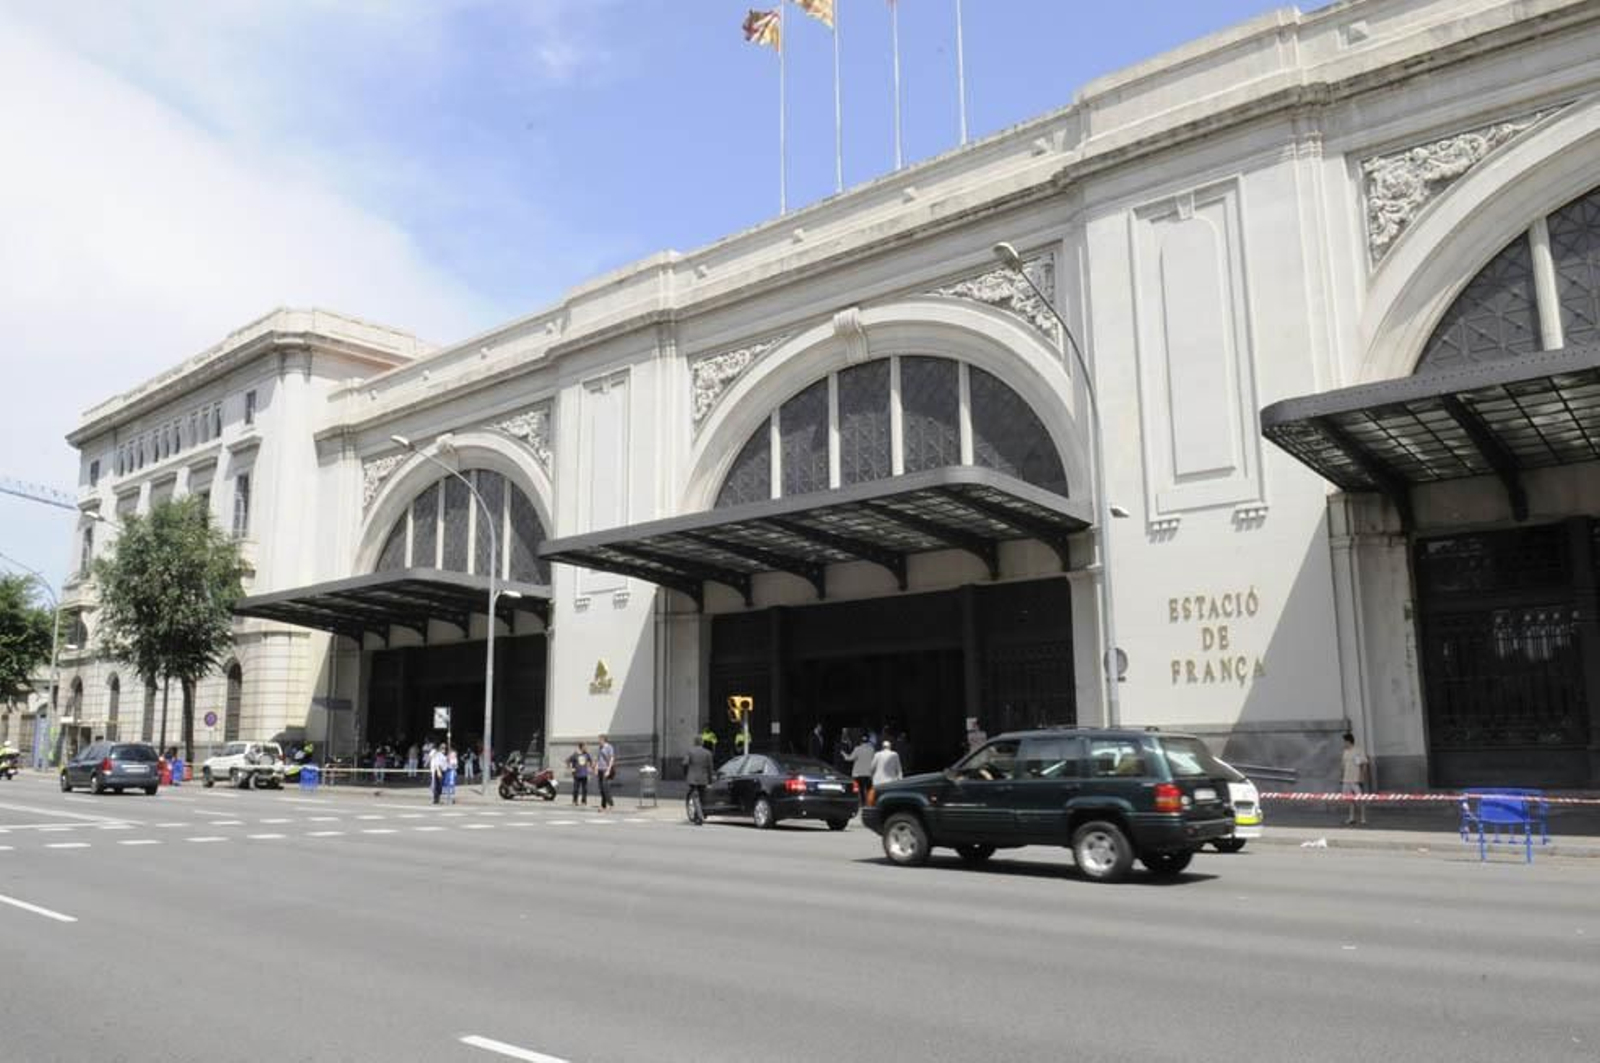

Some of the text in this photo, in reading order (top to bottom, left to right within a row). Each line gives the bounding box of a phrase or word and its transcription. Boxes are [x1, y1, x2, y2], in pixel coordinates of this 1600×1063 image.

[1168, 585, 1259, 623] ESTACIÓ
[1201, 625, 1229, 651] DE
[1171, 656, 1267, 688] FRANÇA
